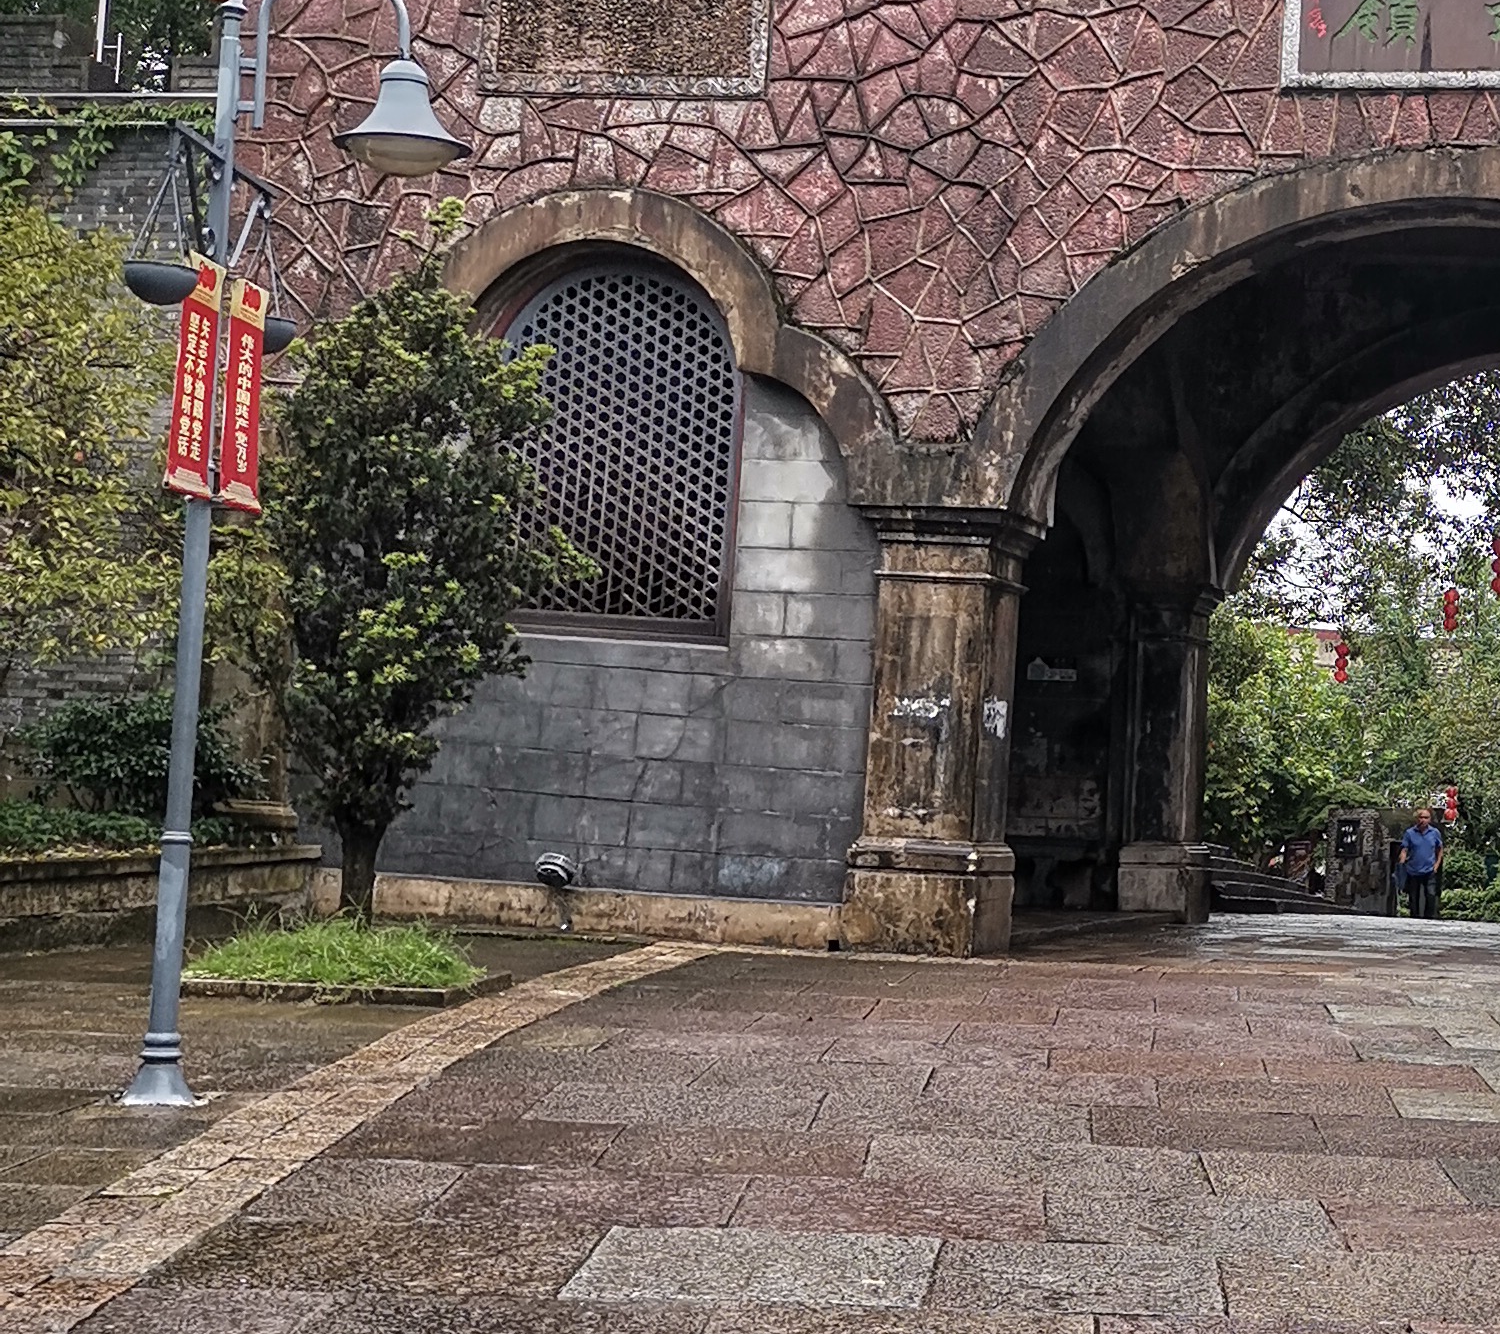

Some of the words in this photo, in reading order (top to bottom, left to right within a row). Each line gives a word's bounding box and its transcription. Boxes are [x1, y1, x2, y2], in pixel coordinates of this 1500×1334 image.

[234, 333, 255, 473] 伟大的中国共产党万岁
